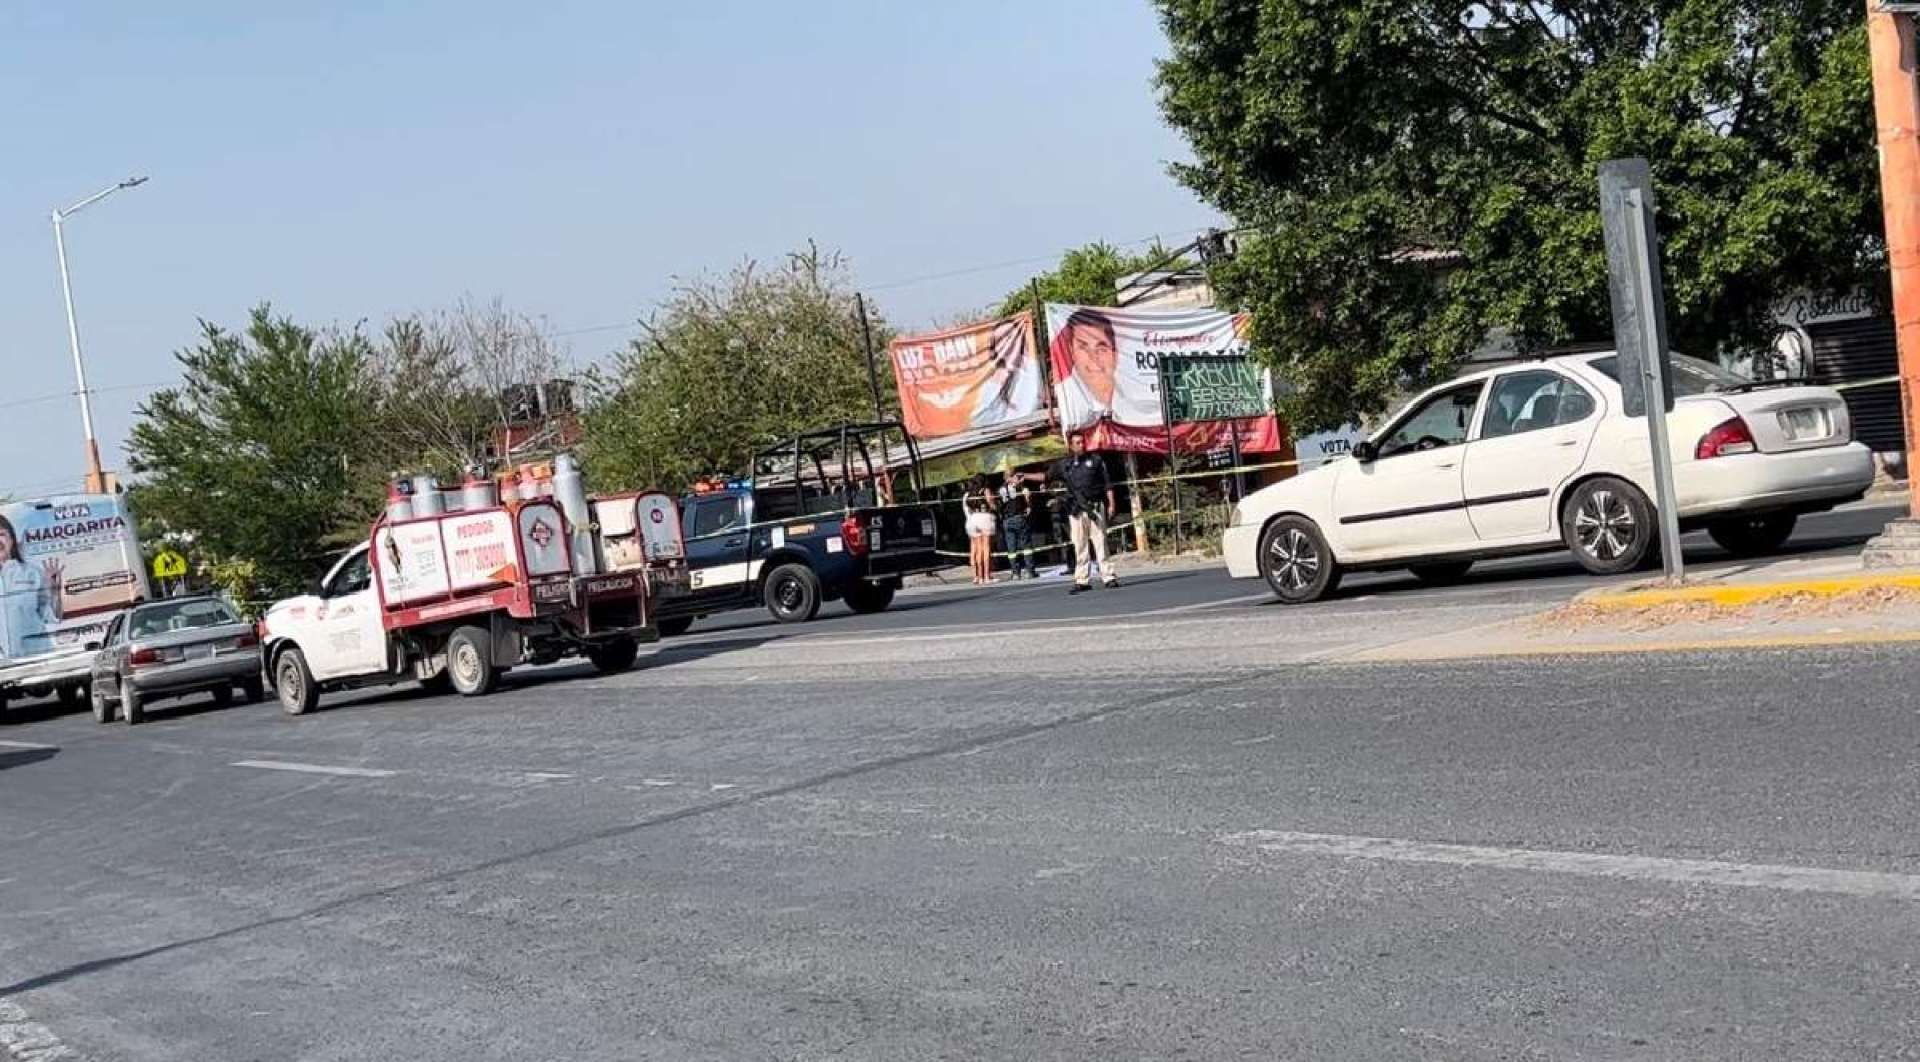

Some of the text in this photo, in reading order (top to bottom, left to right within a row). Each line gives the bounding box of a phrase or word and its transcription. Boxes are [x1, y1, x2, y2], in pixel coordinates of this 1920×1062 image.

[1190, 386, 1259, 403] GENERAL
[1320, 438, 1351, 453] VOTA
[25, 516, 125, 542] MARGARITA
[457, 519, 494, 539] PEDIDOS
[588, 577, 633, 593] PRECAUCION
